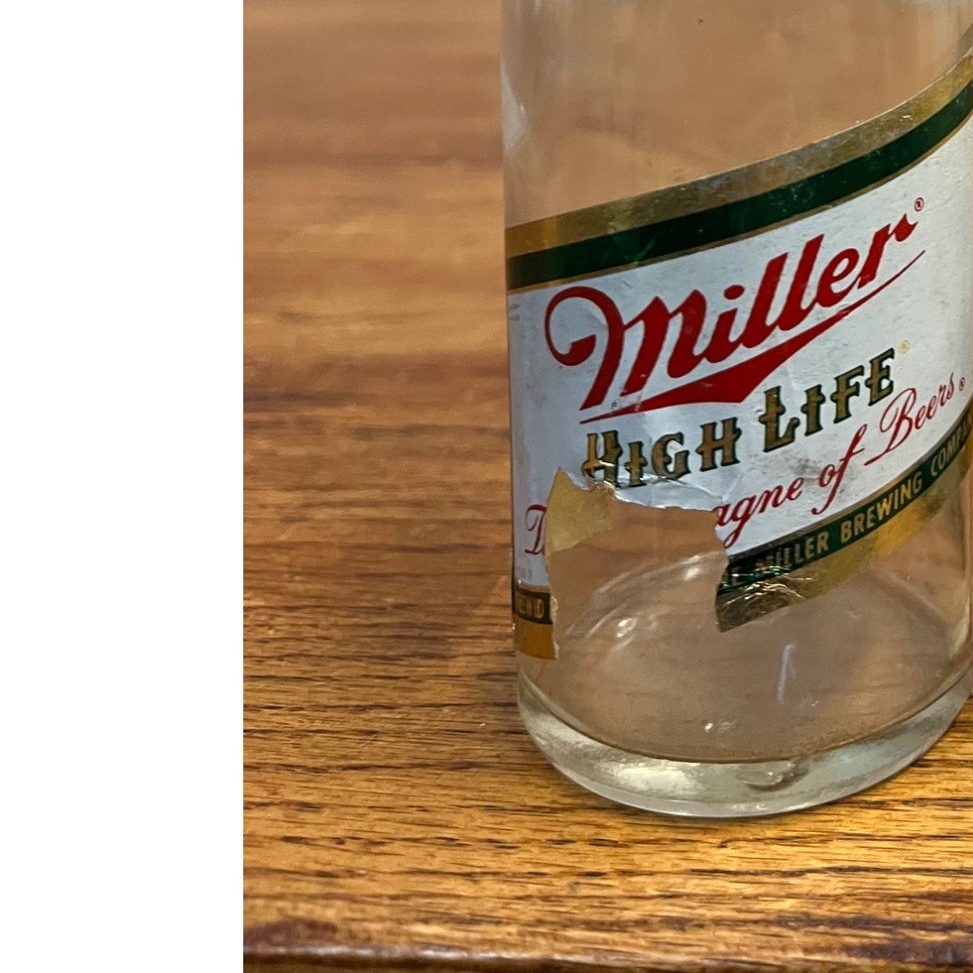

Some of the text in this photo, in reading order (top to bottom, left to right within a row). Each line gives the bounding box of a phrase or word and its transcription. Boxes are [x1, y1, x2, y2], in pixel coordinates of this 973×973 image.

[545, 211, 925, 424] Miller
[581, 348, 896, 489] HIGH LIFE
[811, 424, 868, 515] of
[864, 372, 955, 467] Beers
[841, 473, 923, 543] BREWING
